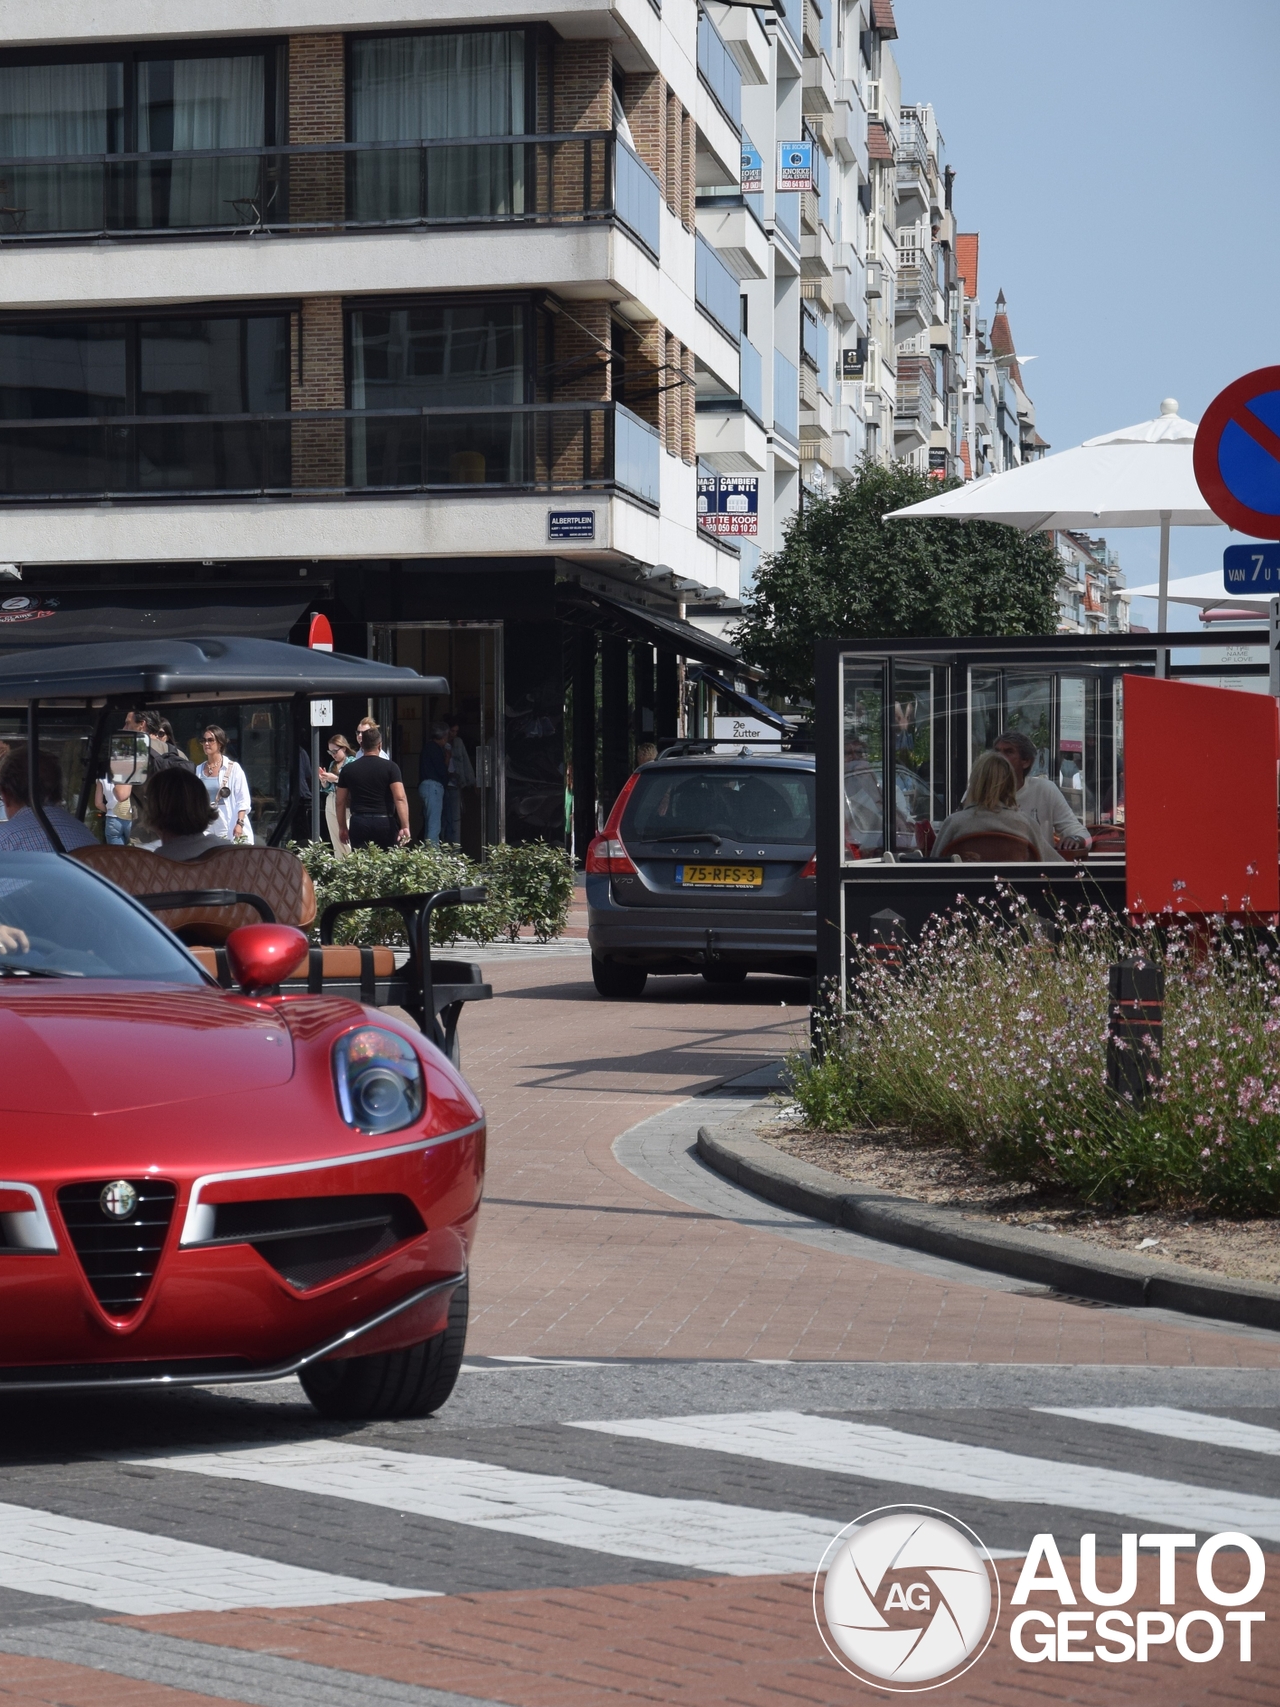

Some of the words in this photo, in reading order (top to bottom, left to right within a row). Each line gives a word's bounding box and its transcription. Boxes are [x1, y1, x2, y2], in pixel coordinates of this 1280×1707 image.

[718, 524, 730, 532] 050
[731, 524, 739, 532] 60
[740, 524, 748, 532] 10
[749, 524, 757, 532] 20
[1228, 569, 1246, 582] VAN
[1251, 554, 1264, 581] 7
[1264, 568, 1271, 580] U
[733, 729, 761, 738] Zutter
[671, 848, 766, 856] VOLVO
[688, 866, 756, 883] 75-RFS-3
